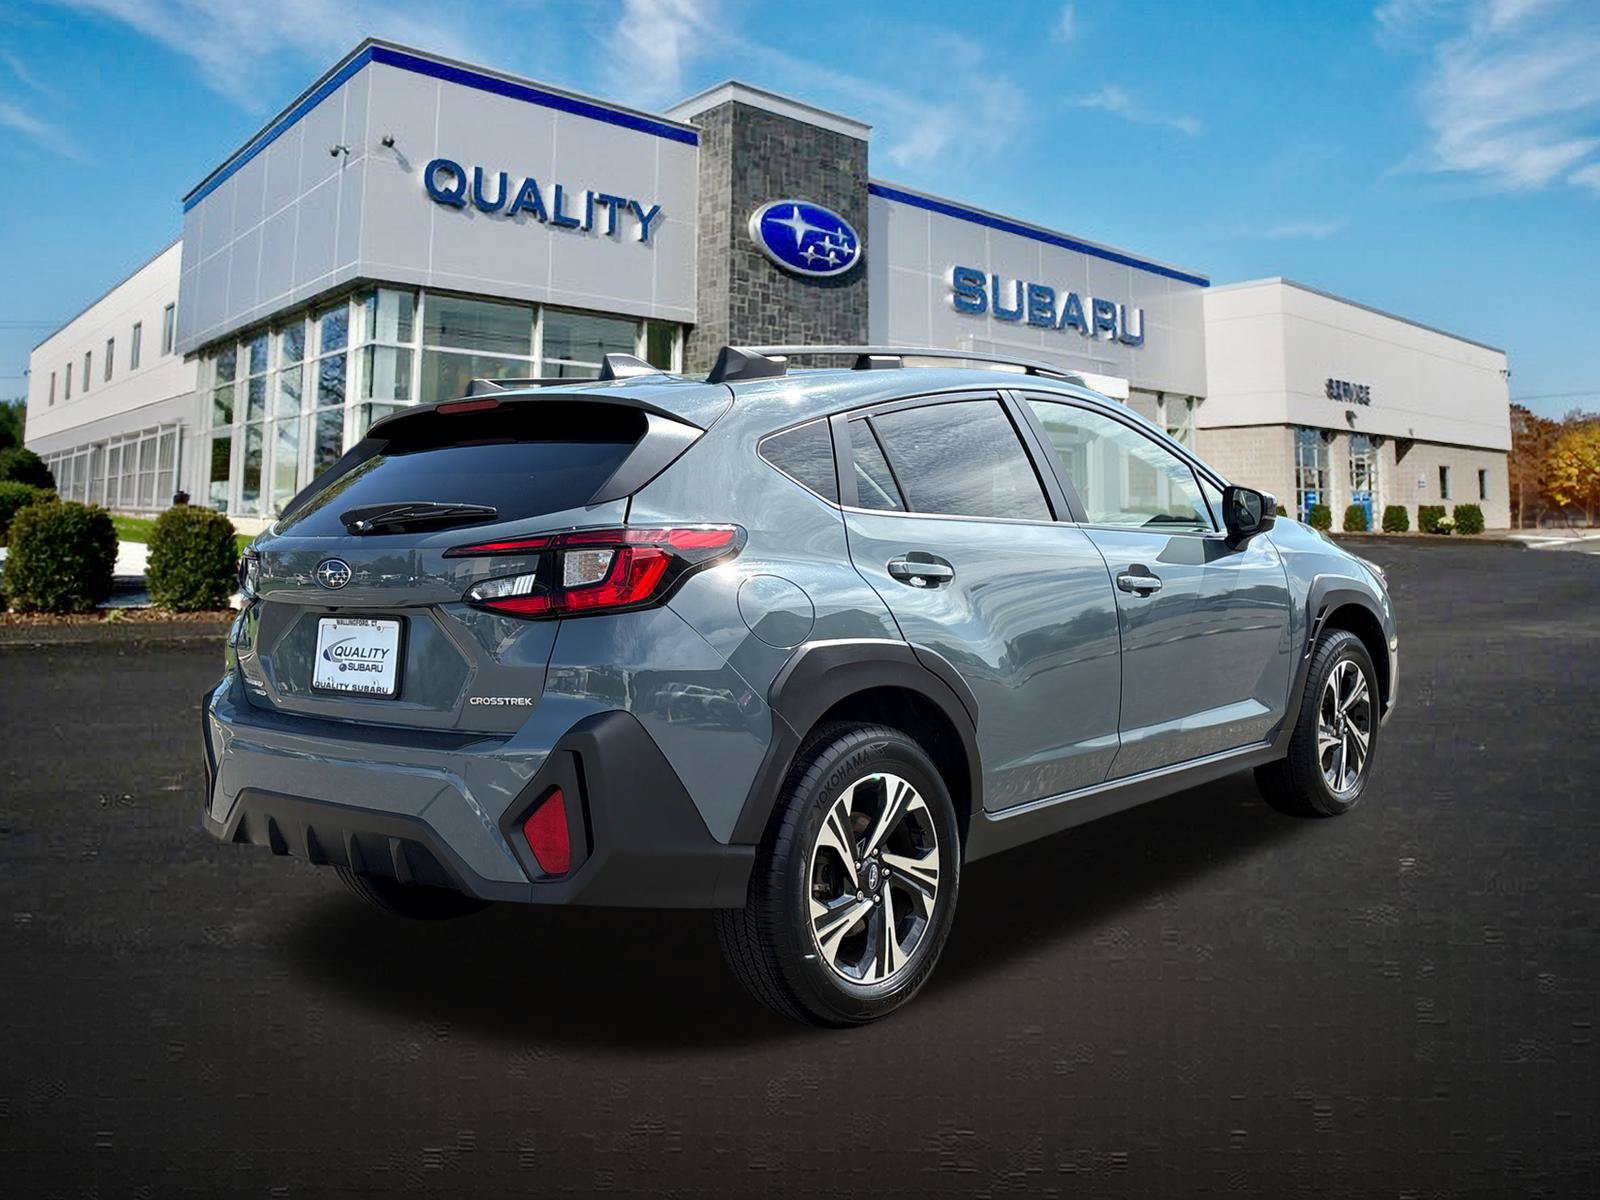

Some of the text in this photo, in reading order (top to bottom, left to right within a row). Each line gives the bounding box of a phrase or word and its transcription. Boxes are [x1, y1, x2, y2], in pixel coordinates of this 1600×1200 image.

[423, 158, 661, 242] QUALITY
[951, 265, 1145, 346] SUBARU
[334, 646, 390, 659] QUALITY
[347, 663, 384, 673] SUBARU
[314, 680, 389, 694] QUALITY SUBARU
[470, 696, 533, 706] CROSSTREK
[813, 748, 871, 810] YOKOHAMA
